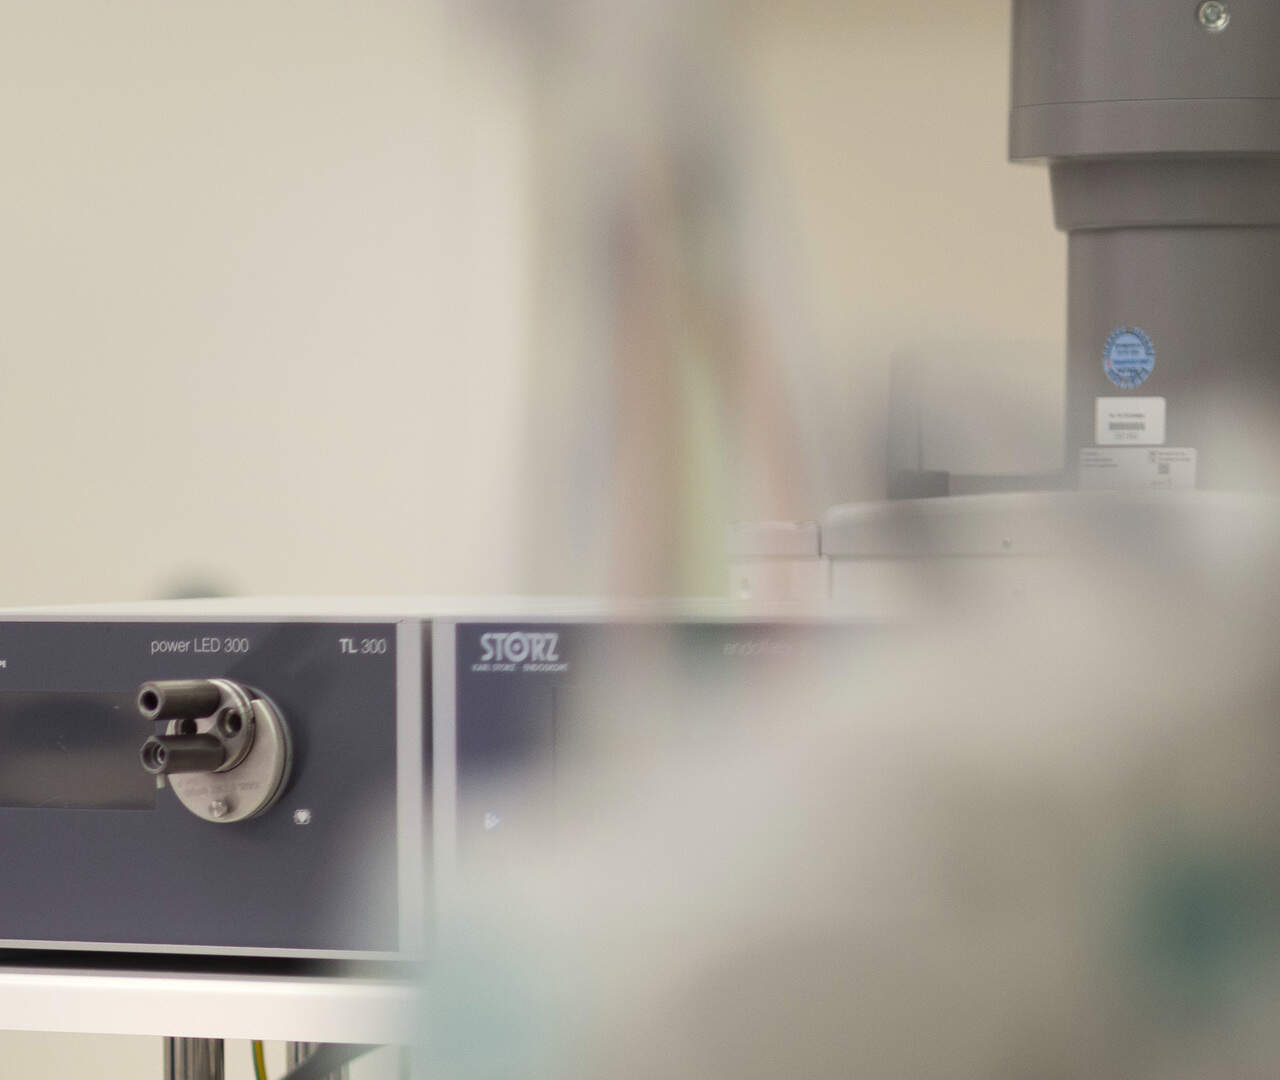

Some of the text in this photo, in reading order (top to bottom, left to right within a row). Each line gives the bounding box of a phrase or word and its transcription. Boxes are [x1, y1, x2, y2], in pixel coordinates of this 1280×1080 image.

[151, 638, 249, 655] power LED 300
[339, 638, 387, 654] TL 300
[481, 632, 560, 662] STORZ
